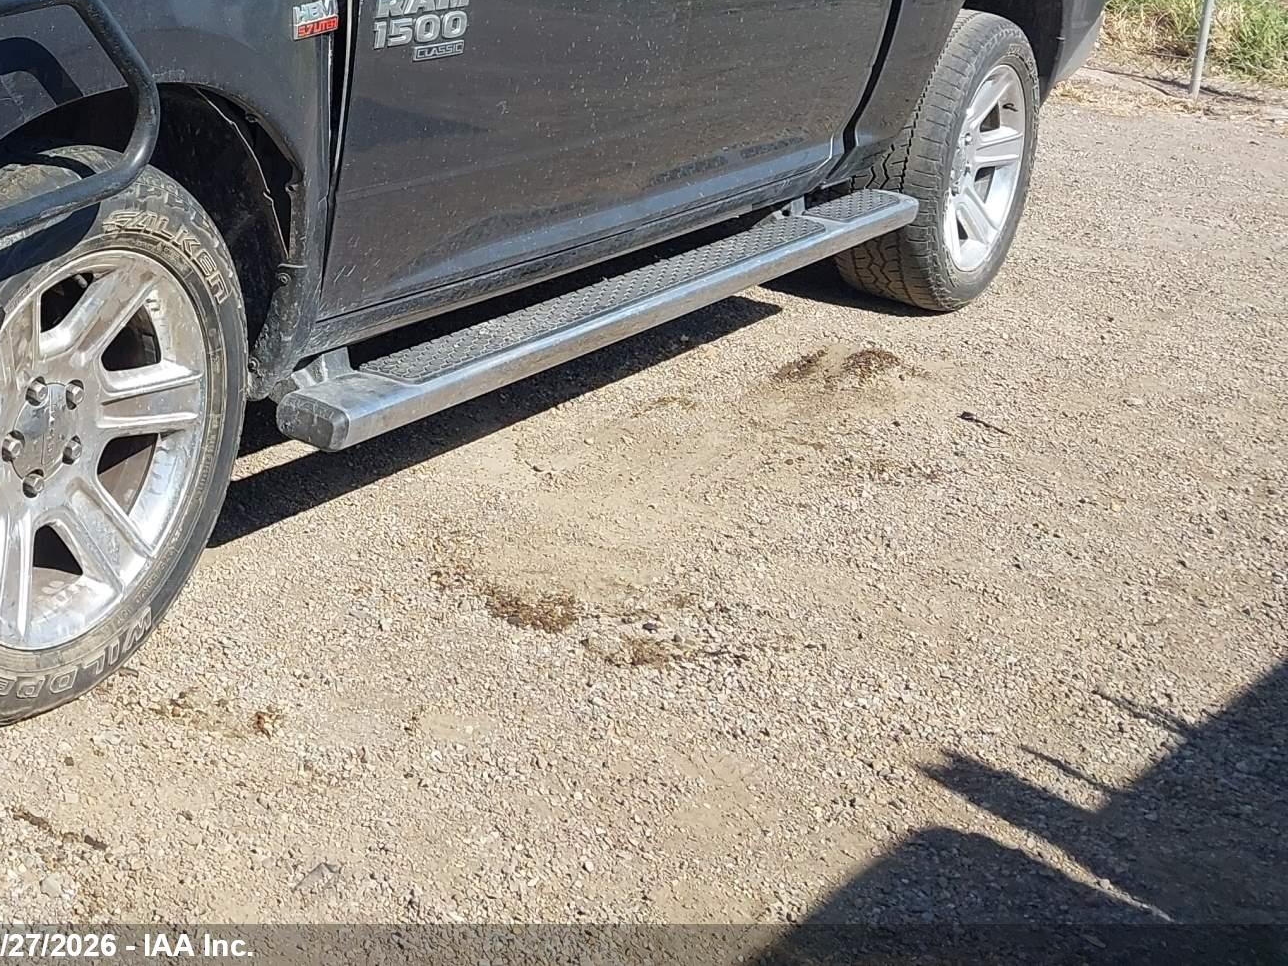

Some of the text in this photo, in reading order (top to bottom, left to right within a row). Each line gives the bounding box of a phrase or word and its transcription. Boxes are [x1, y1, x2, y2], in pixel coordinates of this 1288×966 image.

[373, 11, 468, 50] 1500
[415, 42, 463, 59] CLASSIC
[102, 209, 229, 305] FALKEN
